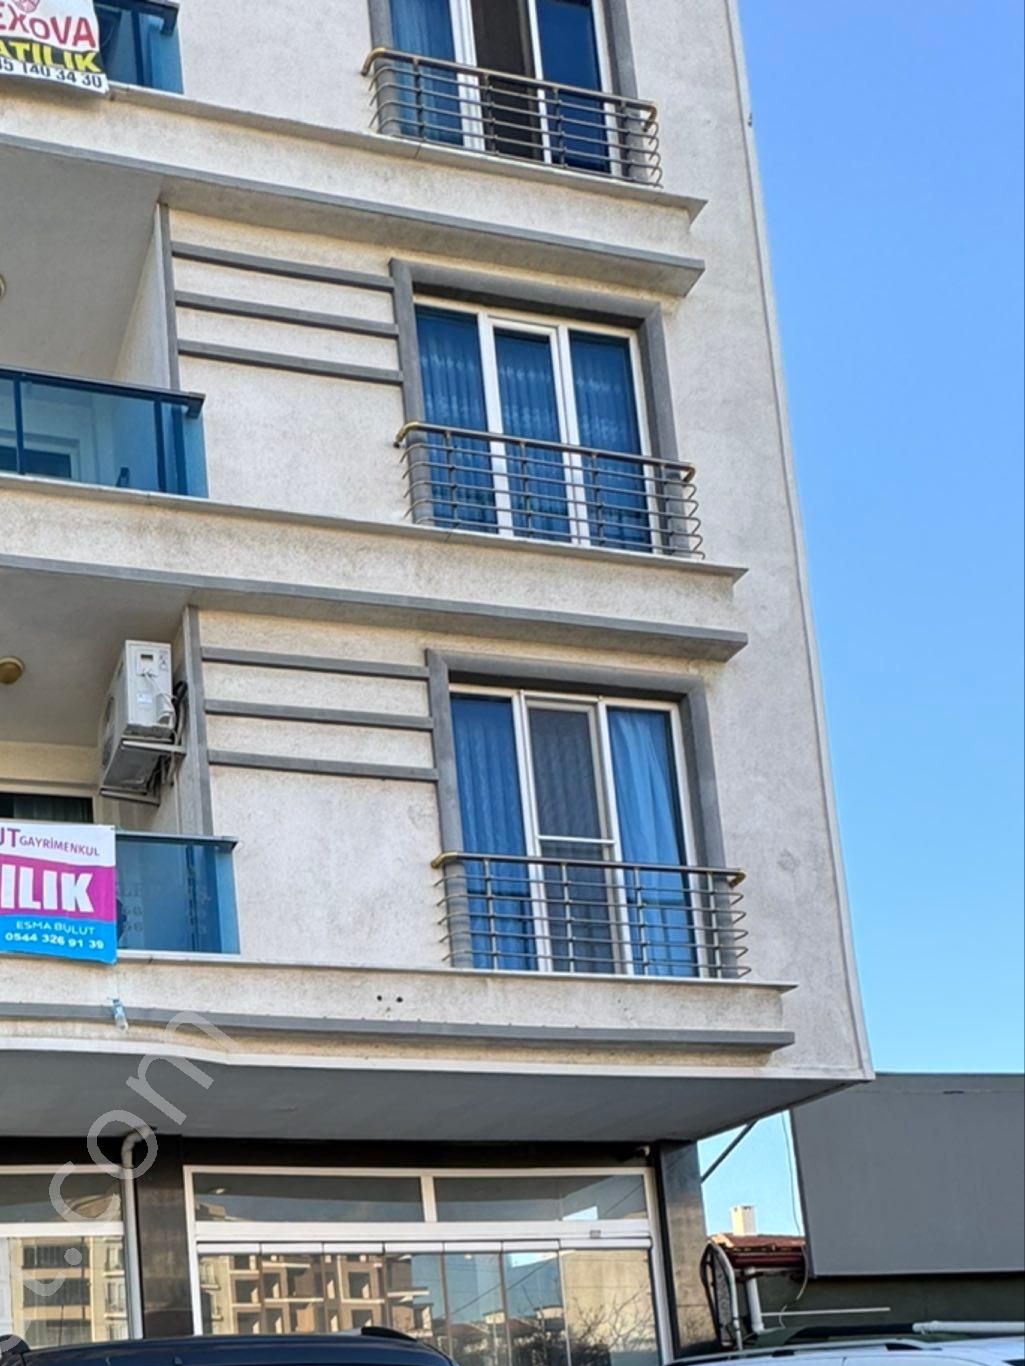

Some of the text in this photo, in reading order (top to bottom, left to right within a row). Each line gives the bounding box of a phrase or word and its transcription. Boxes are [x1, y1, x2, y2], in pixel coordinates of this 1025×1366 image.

[56, 67, 76, 83] 34
[82, 73, 102, 88] 30
[19, 835, 100, 857] GAYRİMENKUL
[5, 931, 38, 942] 0544
[16, 920, 95, 936] ESMA BULUT
